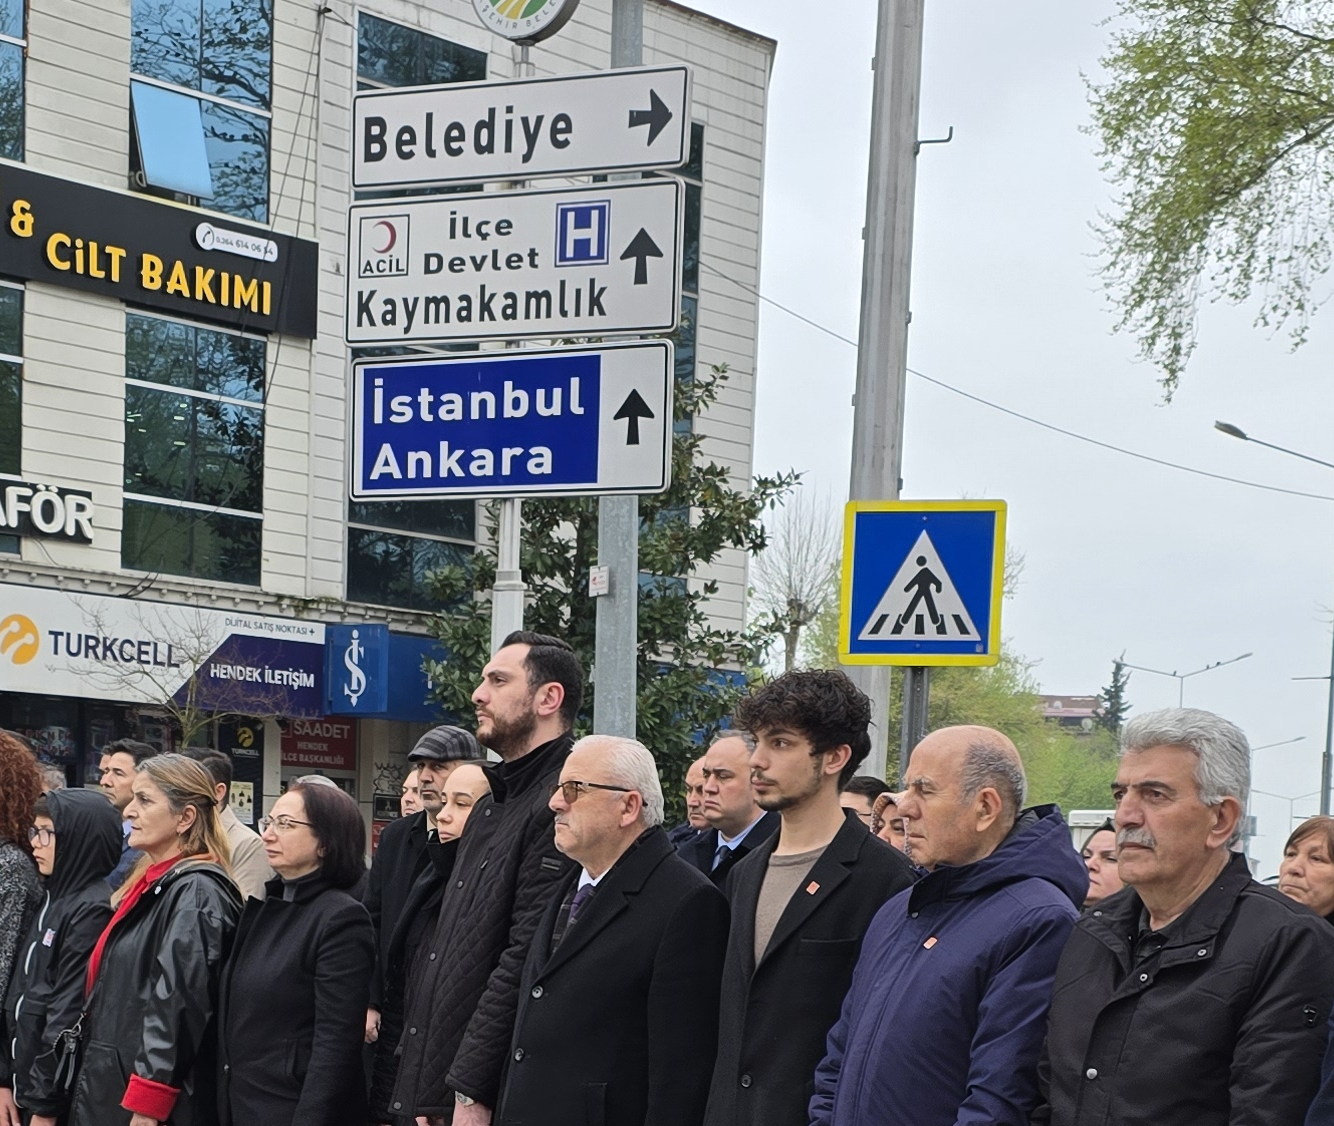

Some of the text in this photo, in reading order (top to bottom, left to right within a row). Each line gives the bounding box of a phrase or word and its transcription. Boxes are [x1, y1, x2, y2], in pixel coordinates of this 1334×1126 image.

[364, 105, 573, 164] Belediye
[449, 211, 513, 241] İlçe
[10, 199, 34, 237] &
[141, 253, 271, 315] BAKIMI
[362, 254, 405, 275] ACİL
[424, 248, 539, 275] Devlet
[356, 278, 608, 335] Kaymakamlık
[372, 376, 585, 425] İstanbul
[369, 442, 553, 481] Ankara
[48, 629, 181, 668] TURKCELL
[210, 663, 315, 690] HENDEK İLETİŞİM
[293, 720, 351, 740] SAADET
[297, 741, 329, 752] HENDEK
